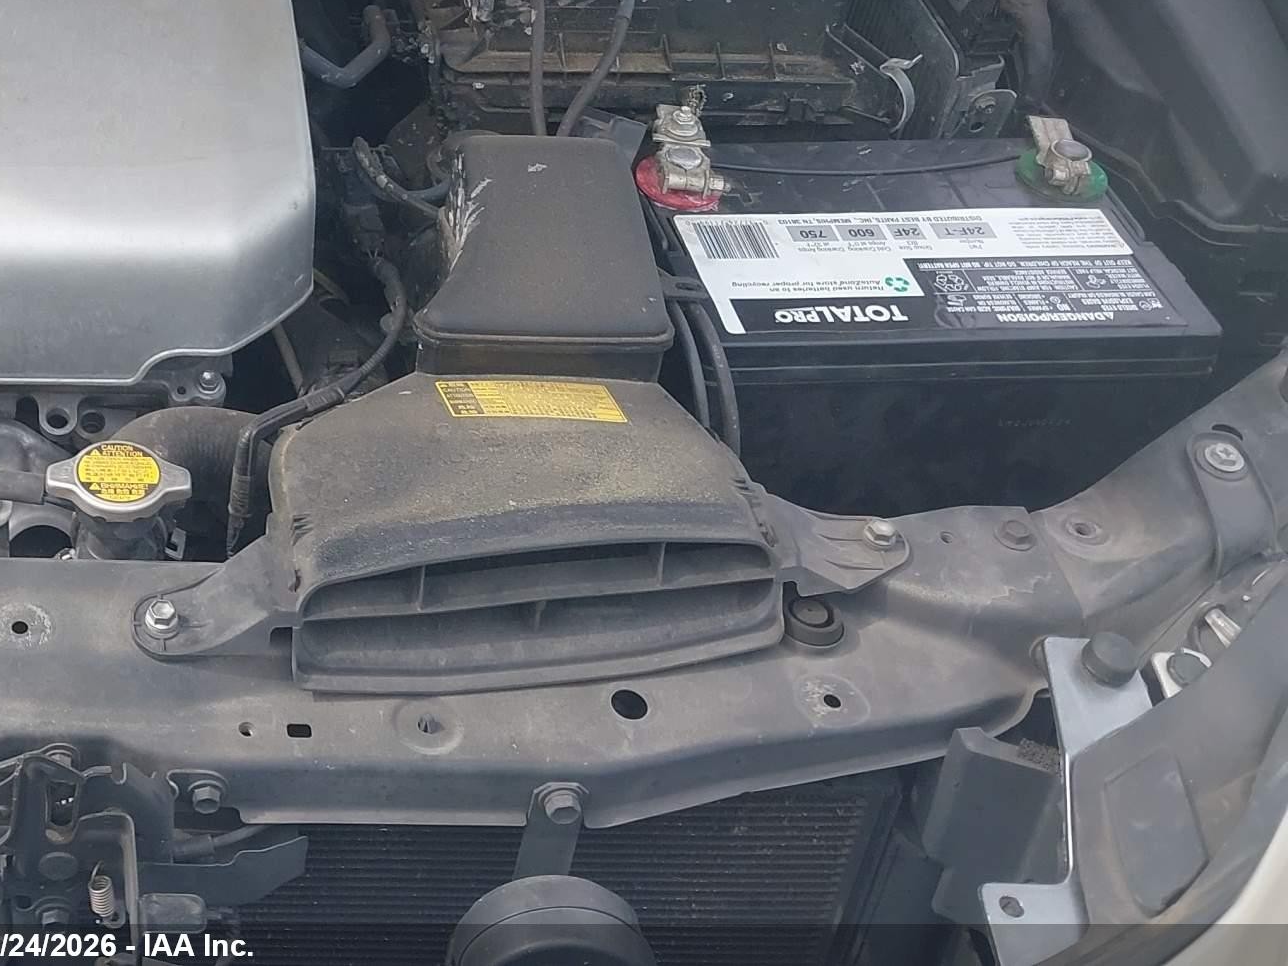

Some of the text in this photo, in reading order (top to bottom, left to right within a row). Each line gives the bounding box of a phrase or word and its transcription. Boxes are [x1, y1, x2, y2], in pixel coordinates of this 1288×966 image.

[800, 230, 828, 239] 750
[848, 229, 875, 237] 600
[893, 228, 920, 236] 24F
[945, 227, 985, 236] 24F-T
[775, 305, 909, 323] TOTALPRO
